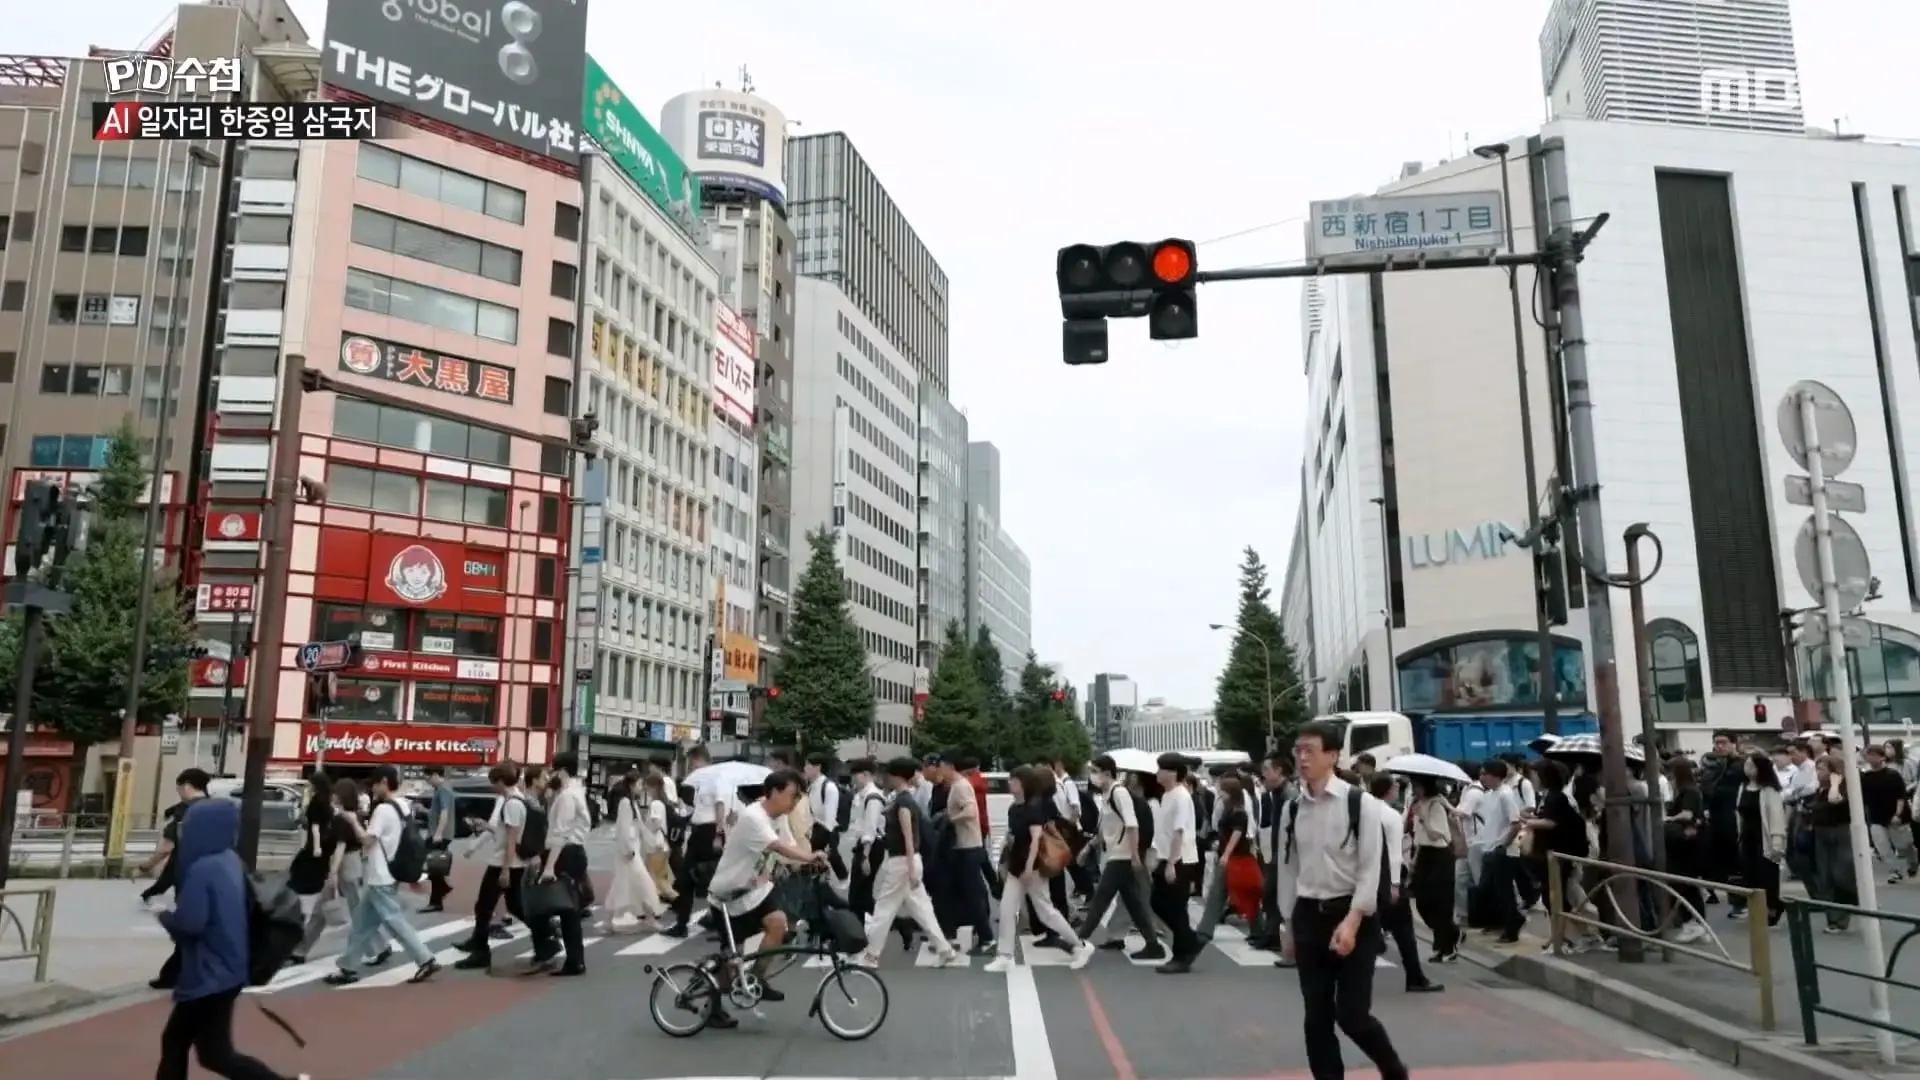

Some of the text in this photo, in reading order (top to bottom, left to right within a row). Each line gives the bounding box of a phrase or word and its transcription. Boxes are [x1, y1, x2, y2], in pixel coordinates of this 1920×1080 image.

[381, 0, 492, 38] gobal
[329, 40, 575, 152] THEグローバル社
[1322, 206, 1492, 237] 西新宿1丁目
[1355, 234, 1449, 250] Nishishinjuku
[398, 350, 509, 401] 大黒屋
[382, 659, 450, 673] First Kitchen
[306, 731, 496, 755] Wndy's First Kitc
